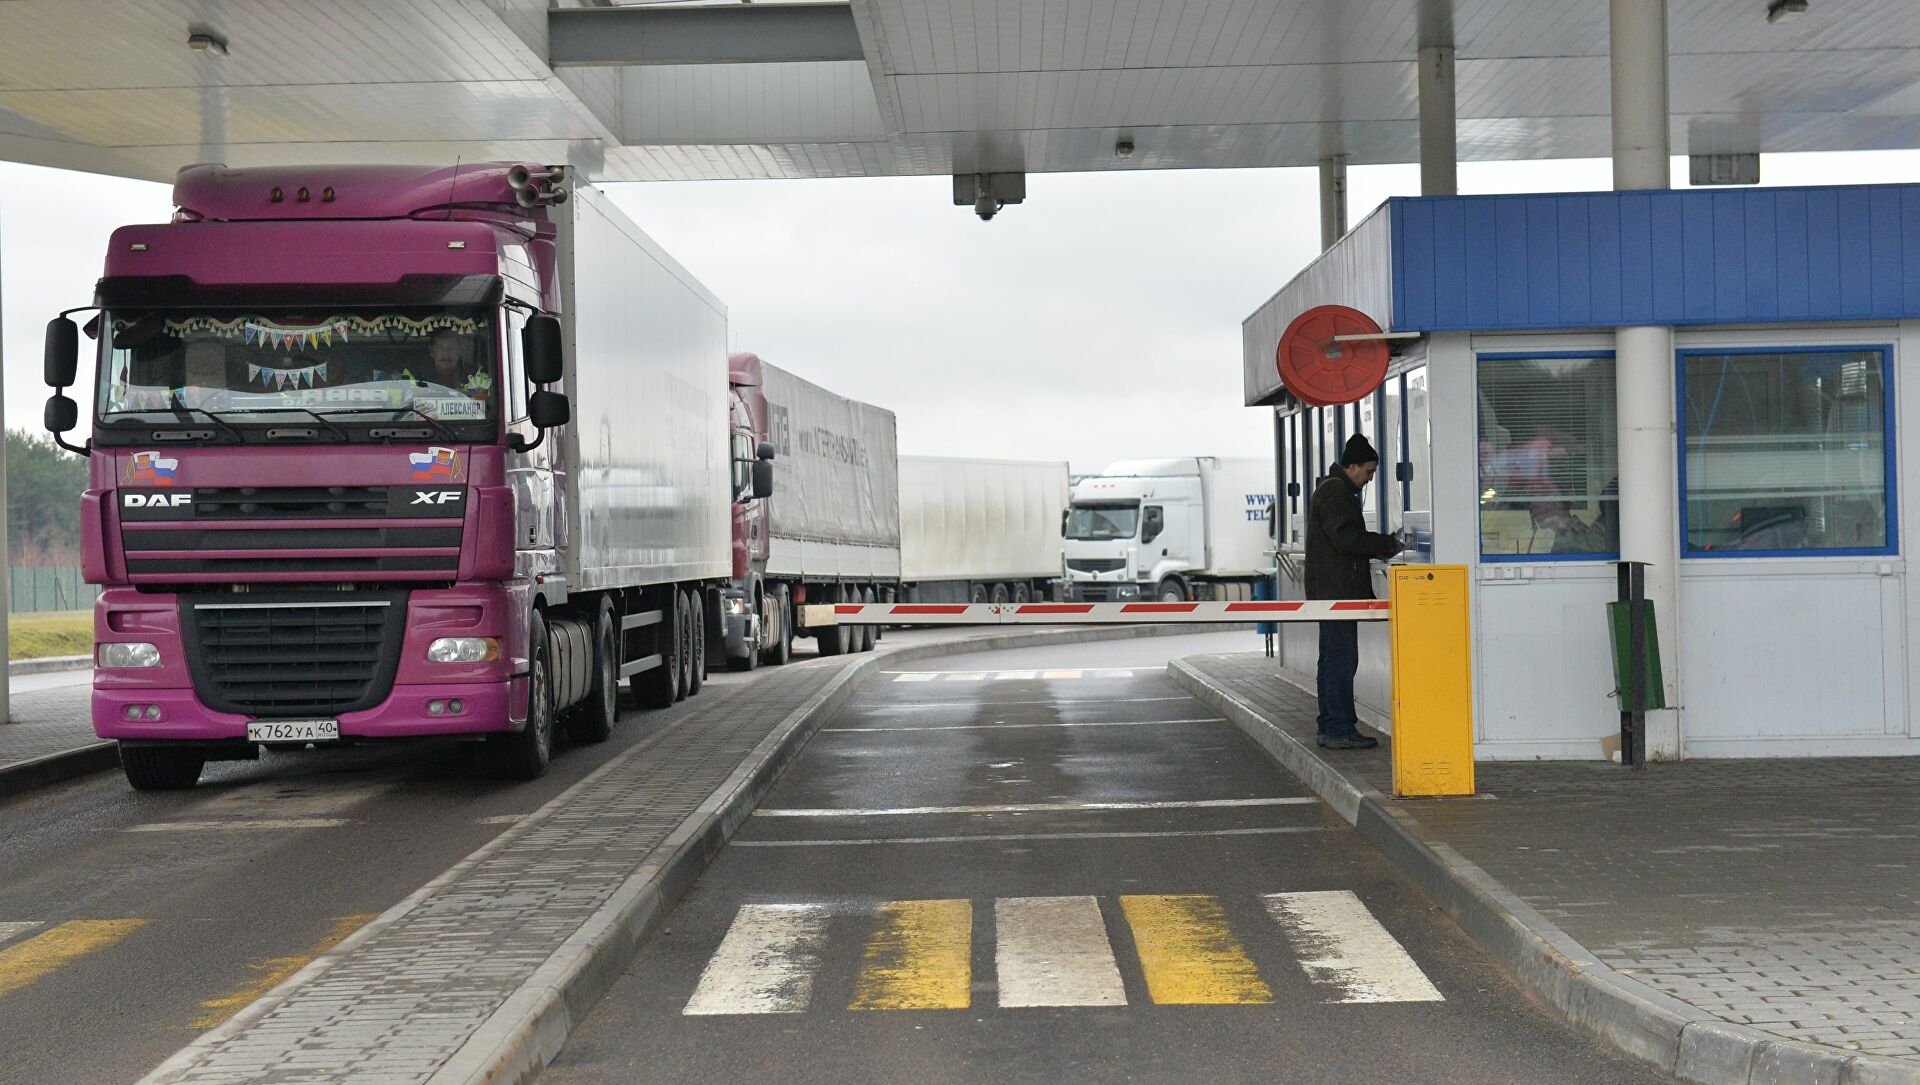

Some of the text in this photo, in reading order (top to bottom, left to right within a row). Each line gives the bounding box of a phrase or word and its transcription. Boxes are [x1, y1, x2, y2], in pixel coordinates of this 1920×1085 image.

[441, 402, 481, 417] АЛЕКСАНДР
[125, 494, 192, 507] DAF
[410, 491, 462, 504] XF
[318, 722, 333, 733] 40
